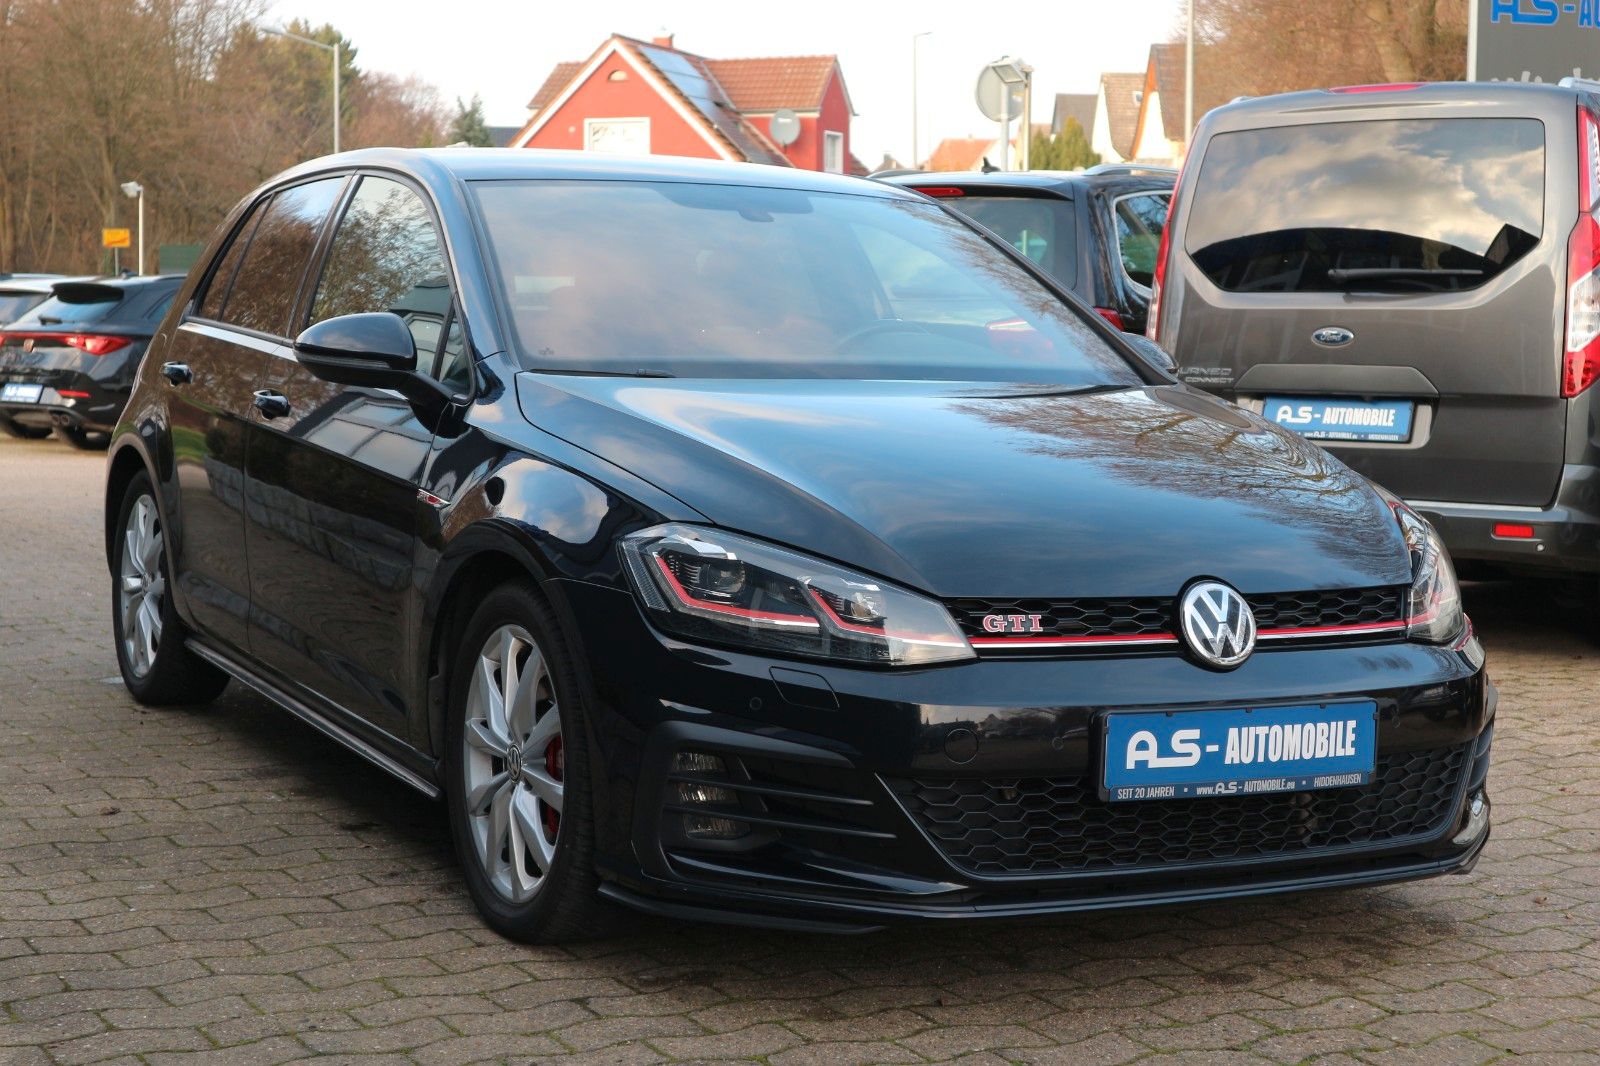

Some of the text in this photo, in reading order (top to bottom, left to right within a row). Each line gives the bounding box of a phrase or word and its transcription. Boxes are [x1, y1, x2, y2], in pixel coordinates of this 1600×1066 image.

[1185, 376, 1234, 384] CONNECT
[983, 614, 1043, 632] GTI
[1118, 788, 1133, 799] SEIT
[1135, 787, 1145, 799] 20
[1146, 786, 1175, 798] JAHREN
[1314, 773, 1361, 787] HIDDENHAUSEN
